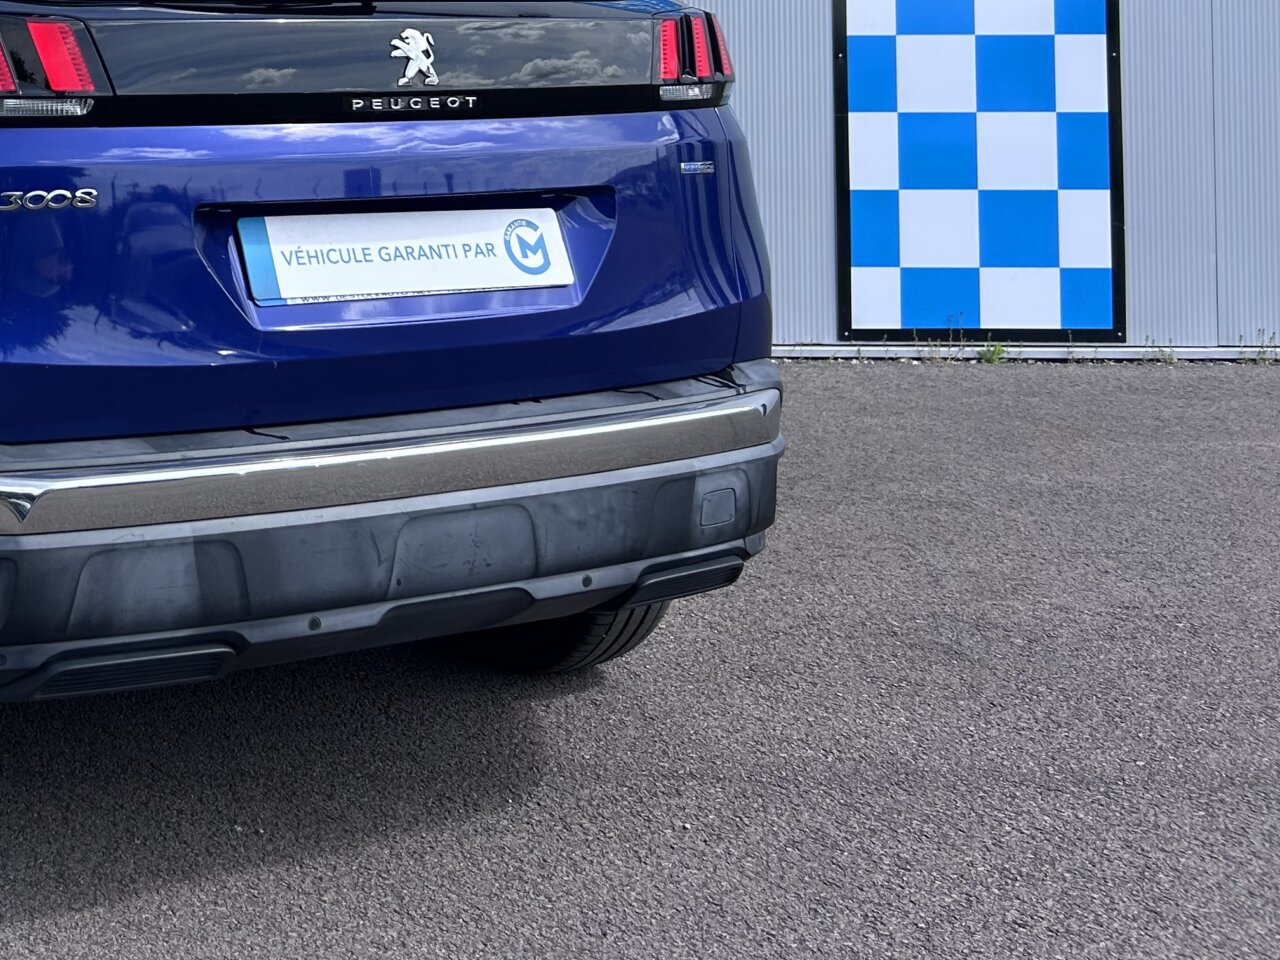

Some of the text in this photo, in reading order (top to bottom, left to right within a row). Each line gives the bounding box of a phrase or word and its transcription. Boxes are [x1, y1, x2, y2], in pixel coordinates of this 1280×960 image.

[351, 96, 477, 111] PEUGEOT
[280, 242, 497, 267] VÉHICULE GARANTI PAR
